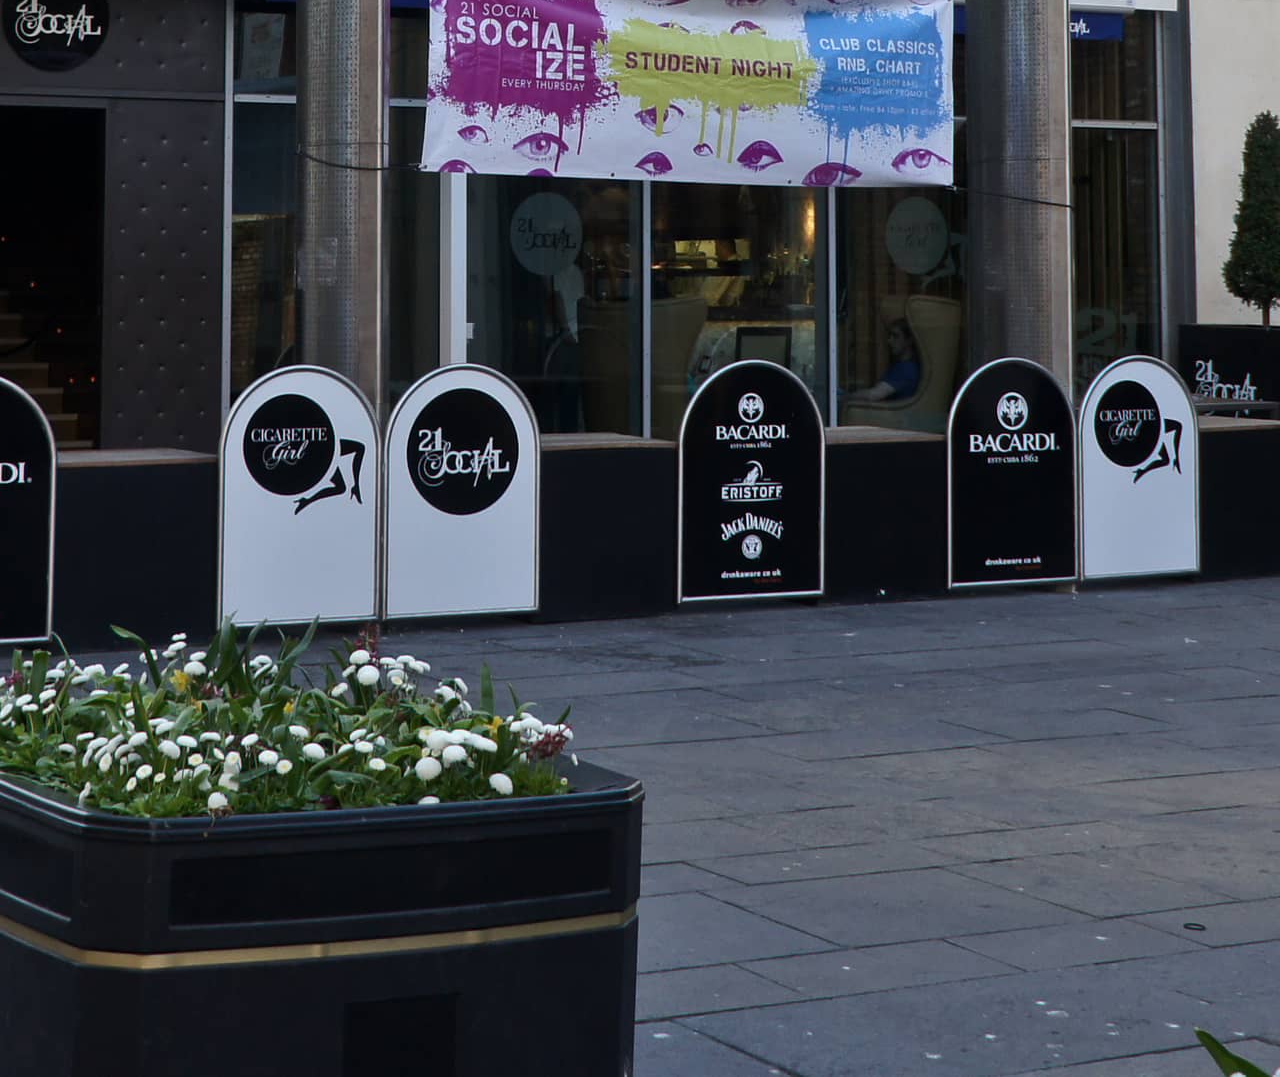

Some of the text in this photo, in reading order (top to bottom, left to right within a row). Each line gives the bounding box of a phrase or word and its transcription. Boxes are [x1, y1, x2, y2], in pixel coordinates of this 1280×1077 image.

[460, 1, 539, 19] 21 SOCIAL
[16, 3, 101, 46] SOCIAL
[456, 15, 585, 53] SOCIAL
[819, 37, 939, 59] CLUB CLASSICS,
[536, 50, 585, 81] IZE
[625, 51, 793, 79] STUDENT NIGHT
[837, 57, 921, 76] RNB, CHART
[501, 77, 585, 92] EVERY THURSDAY
[518, 218, 534, 233] 21
[1195, 359, 1213, 382] 21
[1100, 409, 1156, 422] CIGARETTE
[251, 427, 328, 442] CIGARETTE
[418, 427, 442, 452] 21
[715, 424, 789, 440] BACARDI
[969, 433, 1060, 453] BACARDI
[1110, 419, 1142, 445] Girl
[263, 439, 309, 470] Girl
[418, 436, 510, 488] SOCIAL
[721, 485, 783, 500] ERISTOFF
[720, 512, 784, 541] JACK DANIEL'S
